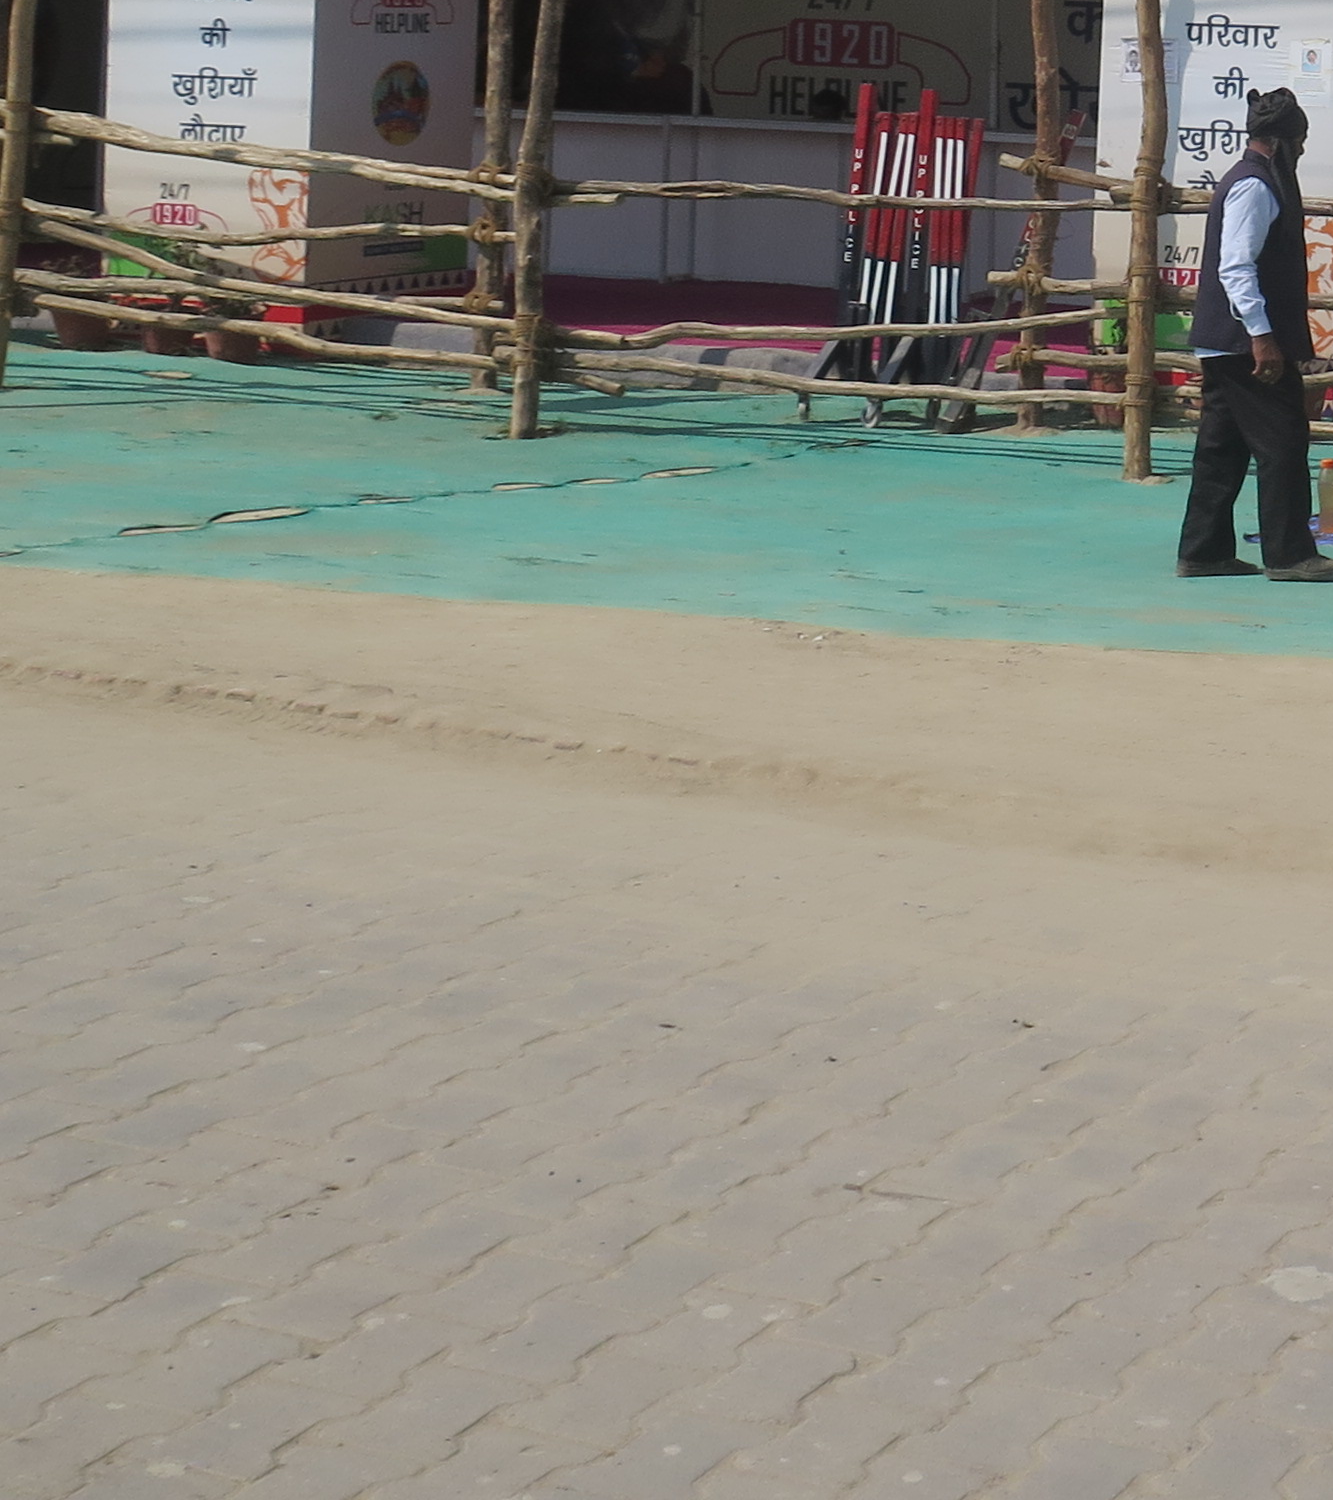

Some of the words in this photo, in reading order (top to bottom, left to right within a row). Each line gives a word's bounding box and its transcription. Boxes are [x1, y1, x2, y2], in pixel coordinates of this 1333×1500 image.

[200, 19, 230, 48] की
[375, 13, 430, 34] HELPLINE
[1185, 18, 1280, 50] परिवार
[796, 22, 888, 65] 1920
[172, 67, 257, 106] खुशियाँ
[1212, 66, 1249, 99] की
[1178, 119, 1249, 162] खुशि
[852, 149, 864, 172] UP
[917, 155, 928, 179] UP
[160, 182, 190, 200] 24/7
[155, 205, 195, 224] 1920
[843, 184, 859, 262] PLICE
[1164, 245, 1199, 265] 24/7
